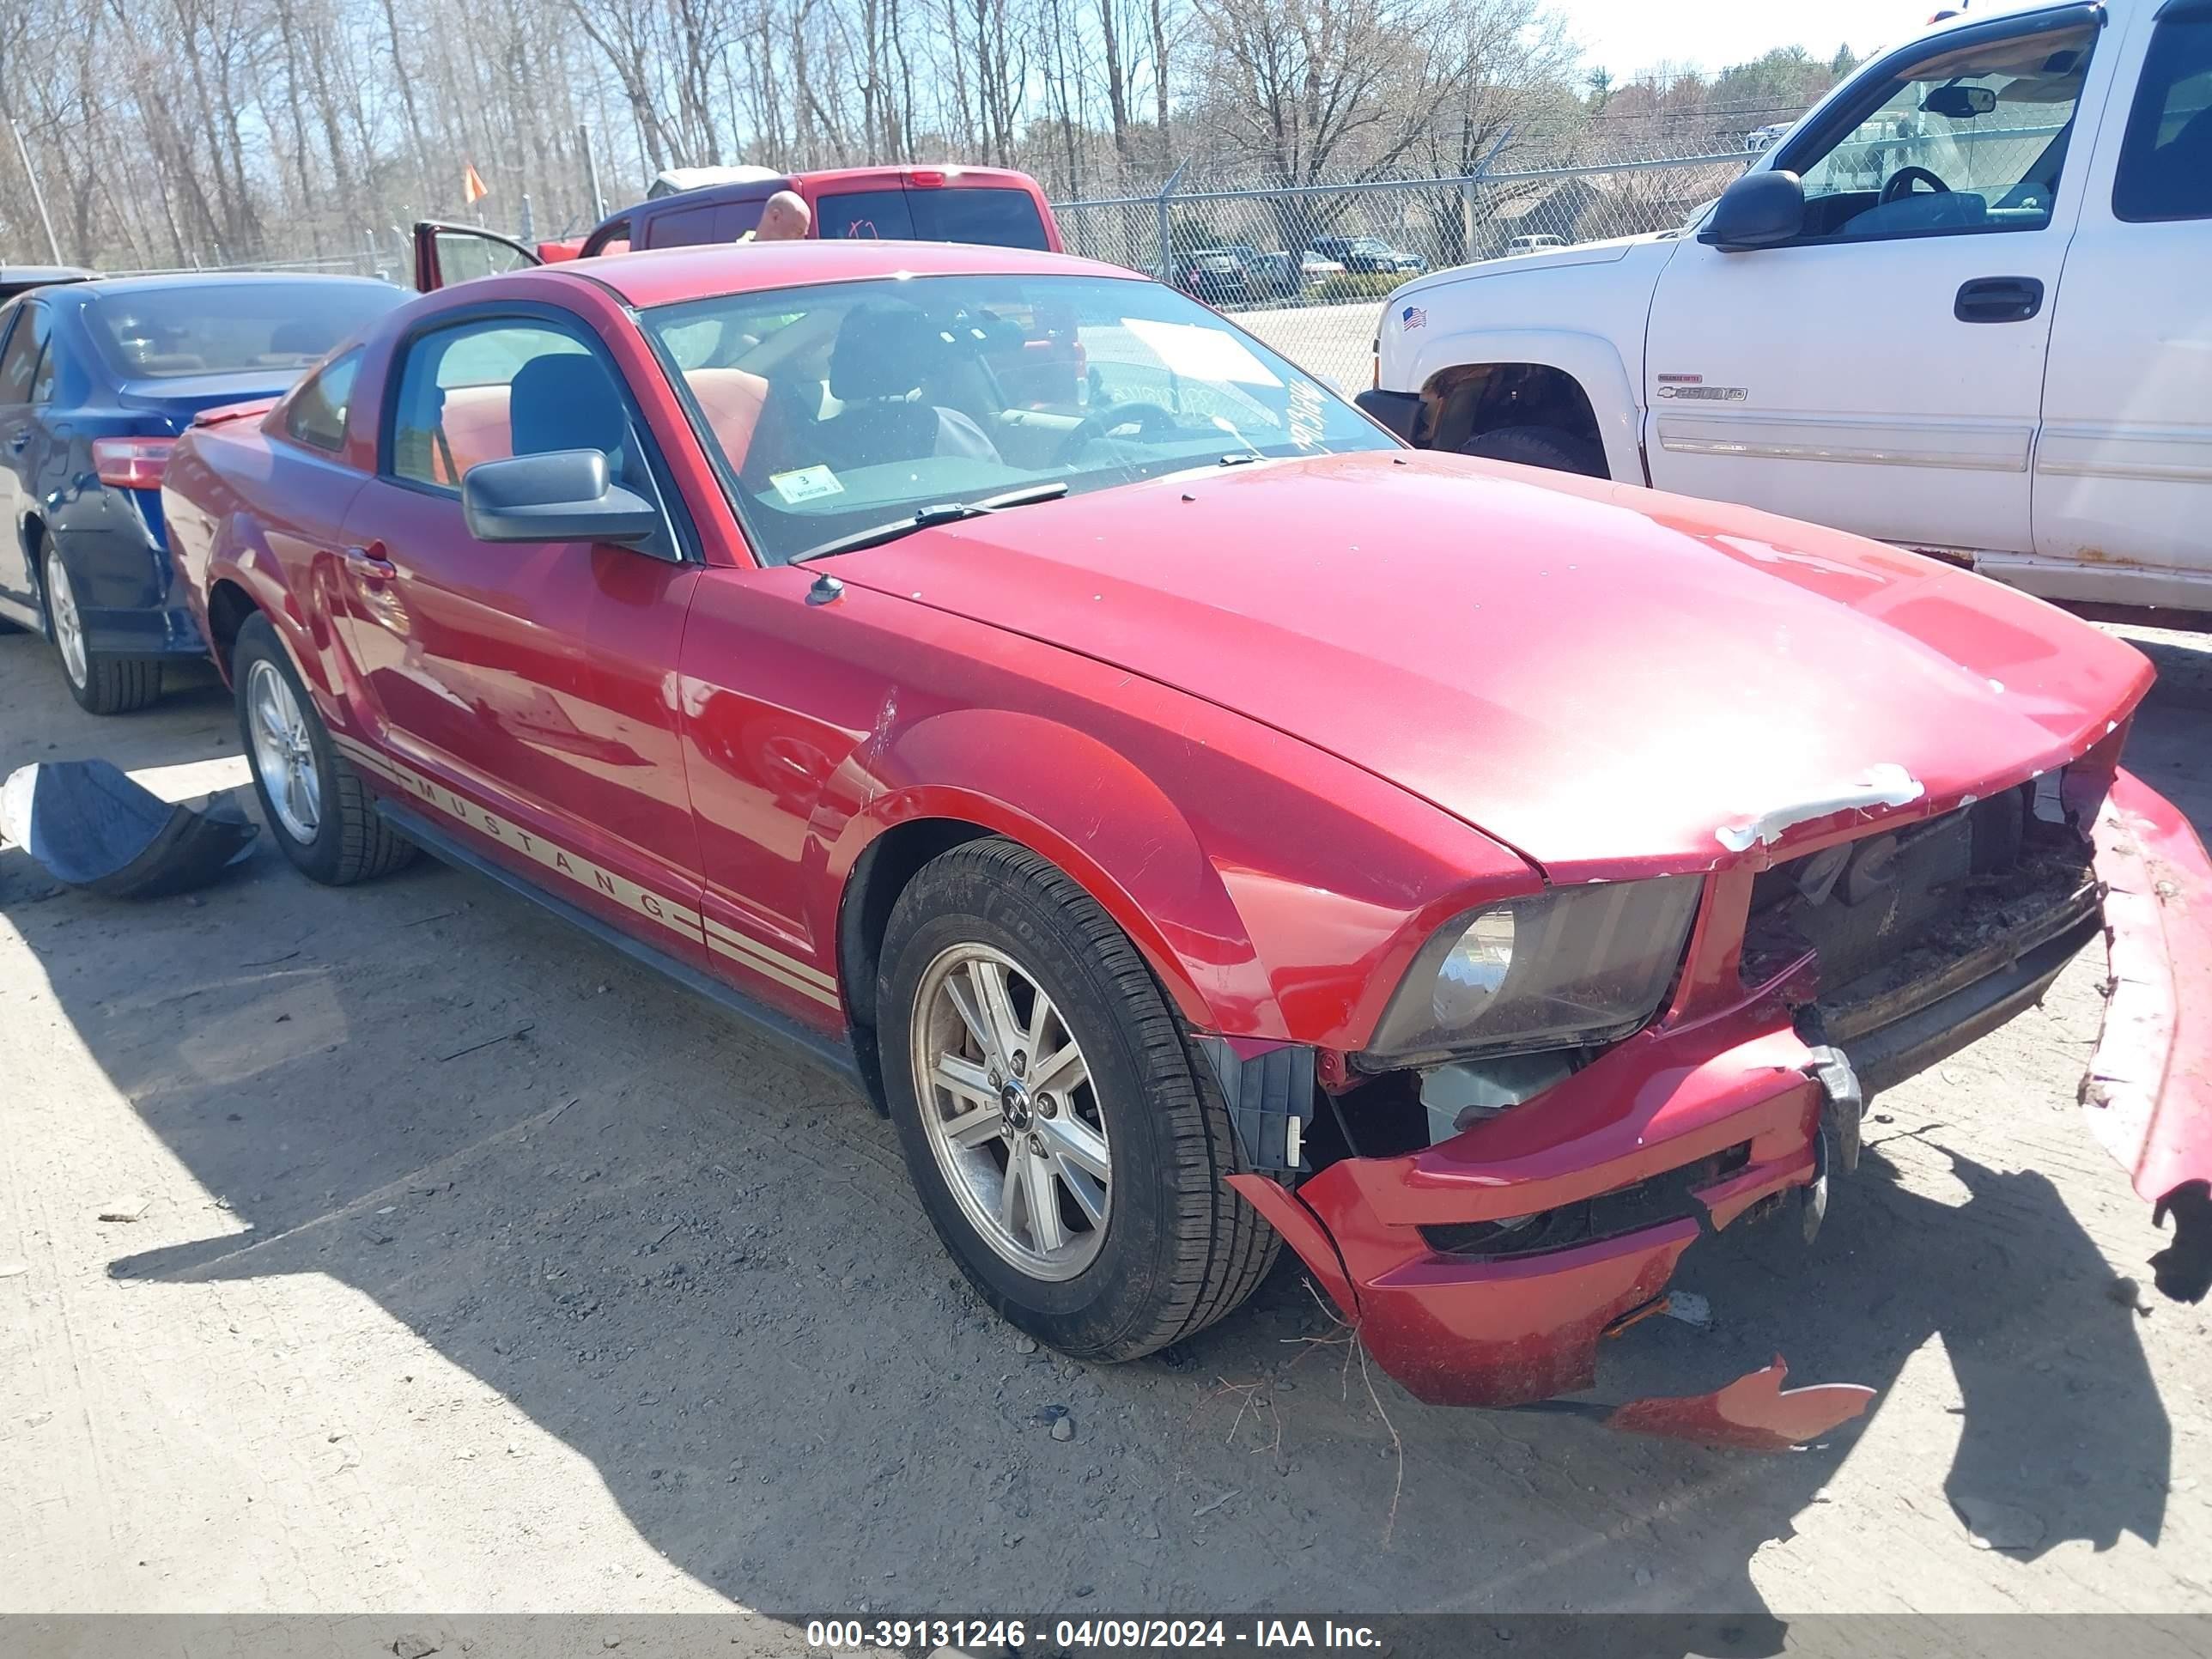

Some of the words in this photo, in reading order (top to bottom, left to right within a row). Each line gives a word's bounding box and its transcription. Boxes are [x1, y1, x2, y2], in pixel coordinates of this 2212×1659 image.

[1676, 387, 1724, 399] 2500
[799, 476, 810, 485] 3
[417, 774, 664, 919] MUSTANG
